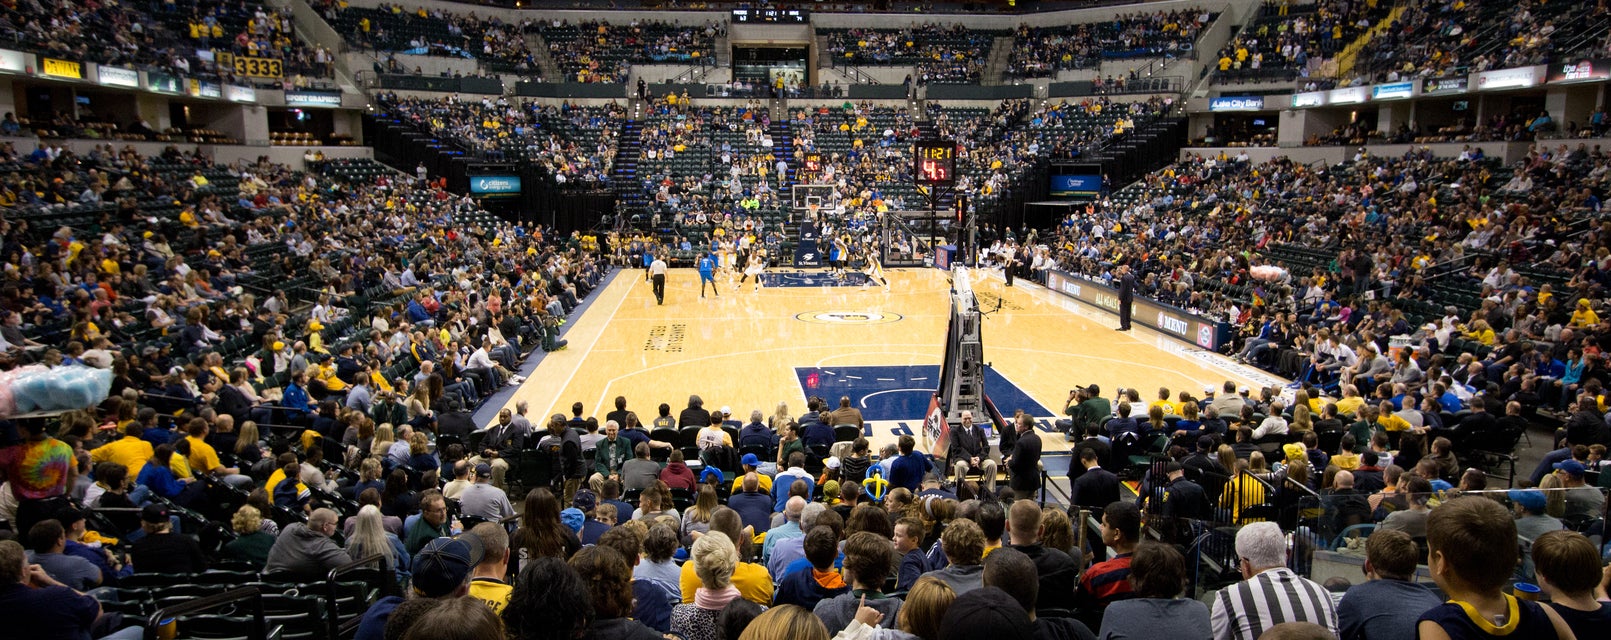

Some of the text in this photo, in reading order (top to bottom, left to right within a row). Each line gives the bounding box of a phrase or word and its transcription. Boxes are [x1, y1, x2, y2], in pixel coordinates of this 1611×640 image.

[236, 58, 281, 76] 3333
[286, 94, 341, 103] SPORT GRAPHICS
[1231, 100, 1245, 108] City
[1246, 99, 1263, 107] Bank
[923, 147, 950, 160] 11:21
[1164, 315, 1188, 335] MENU
